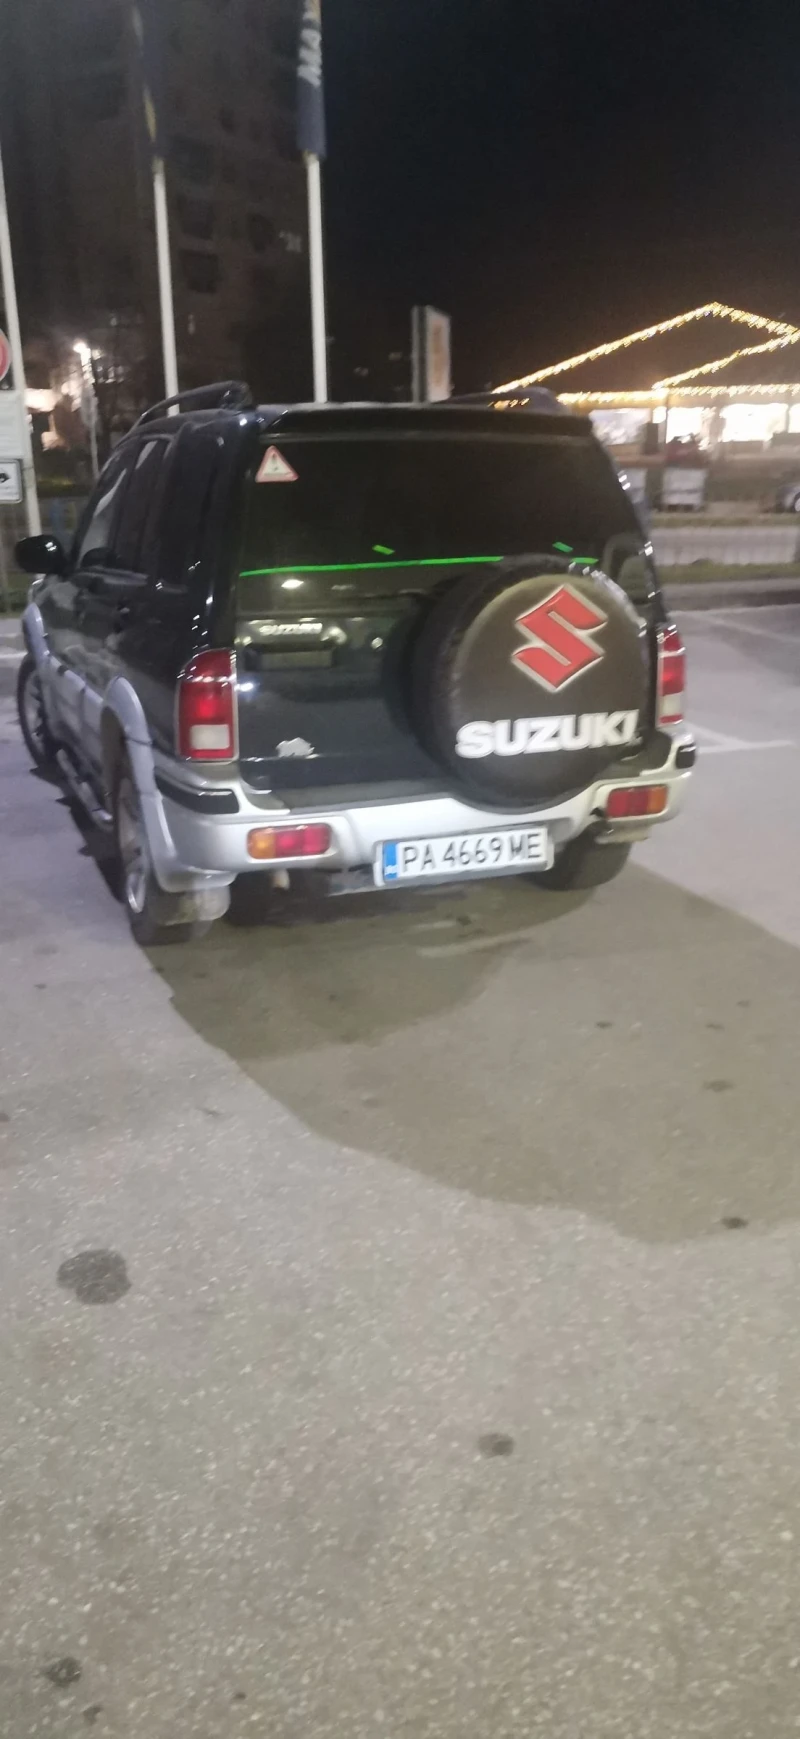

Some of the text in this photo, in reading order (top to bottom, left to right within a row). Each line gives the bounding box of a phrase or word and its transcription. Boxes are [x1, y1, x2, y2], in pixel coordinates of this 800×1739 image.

[455, 709, 640, 759] SUZUKI
[402, 843, 437, 874] PA
[442, 836, 502, 866] 4669
